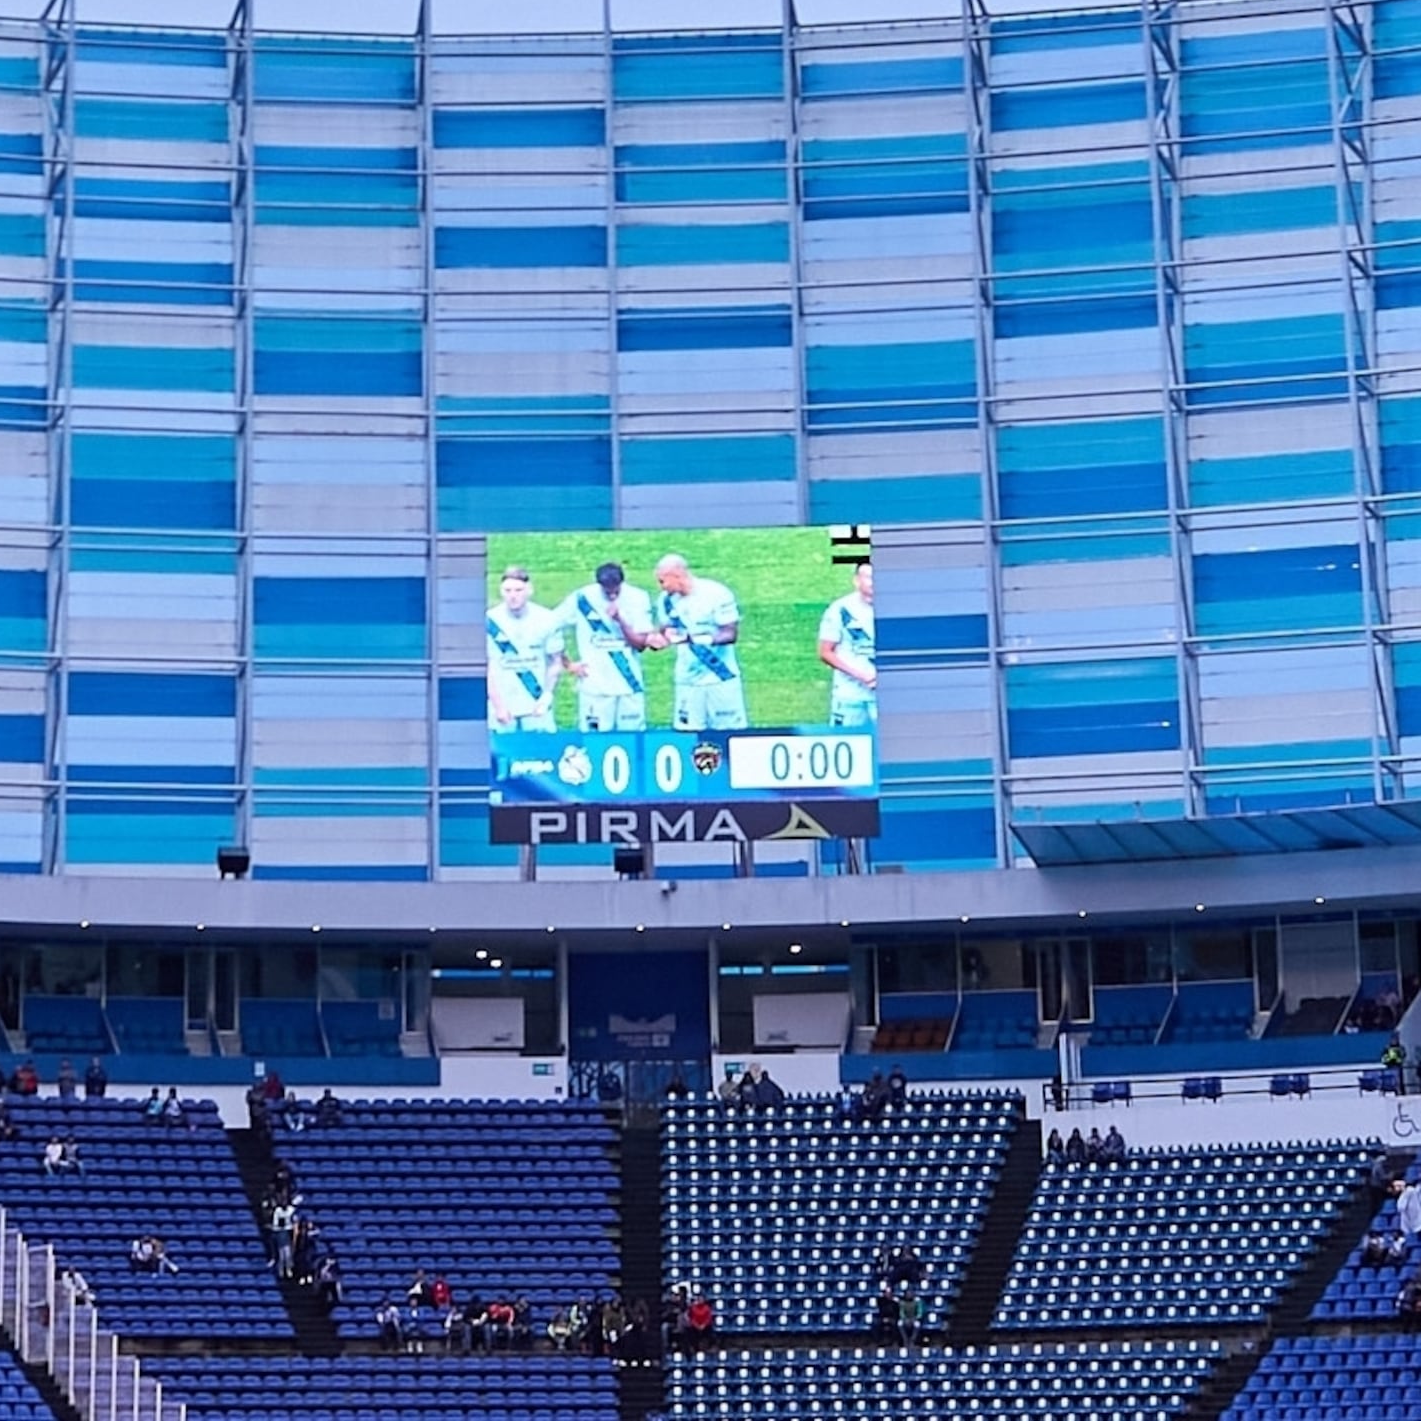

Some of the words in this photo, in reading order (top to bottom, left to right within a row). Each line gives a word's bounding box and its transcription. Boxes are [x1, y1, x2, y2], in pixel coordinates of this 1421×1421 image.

[602, 745, 631, 794] 0
[655, 744, 683, 793] 0
[771, 741, 853, 781] 0:00
[530, 809, 747, 844] PIRMA
